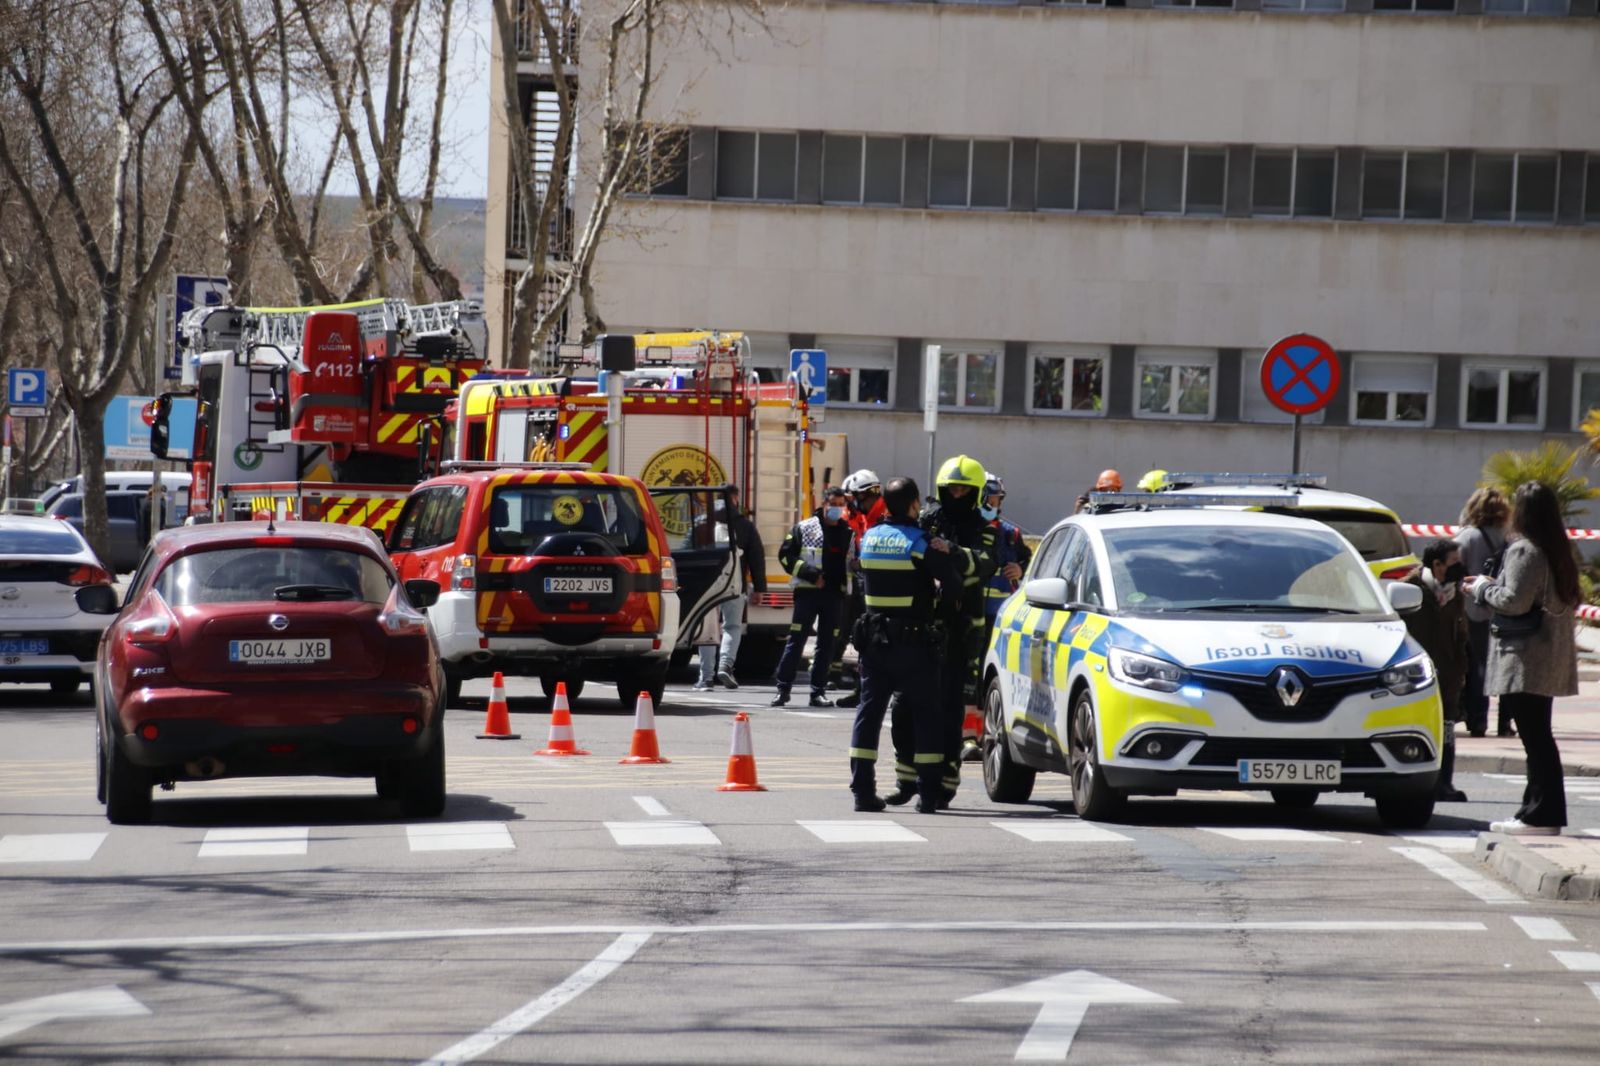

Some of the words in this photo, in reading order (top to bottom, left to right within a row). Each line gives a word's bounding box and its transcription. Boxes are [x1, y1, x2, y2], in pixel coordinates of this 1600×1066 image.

[327, 363, 353, 377] 112
[15, 372, 39, 402] P
[553, 579, 583, 592] 2202
[587, 579, 609, 592] JVS
[0, 640, 18, 652] 75
[21, 640, 46, 652] LBS
[242, 642, 287, 659] 0044
[294, 642, 327, 658] JXB
[5, 656, 20, 665] SP
[132, 666, 166, 678] JUKE
[1252, 763, 1297, 780] 5579
[1303, 763, 1337, 780] LRC
